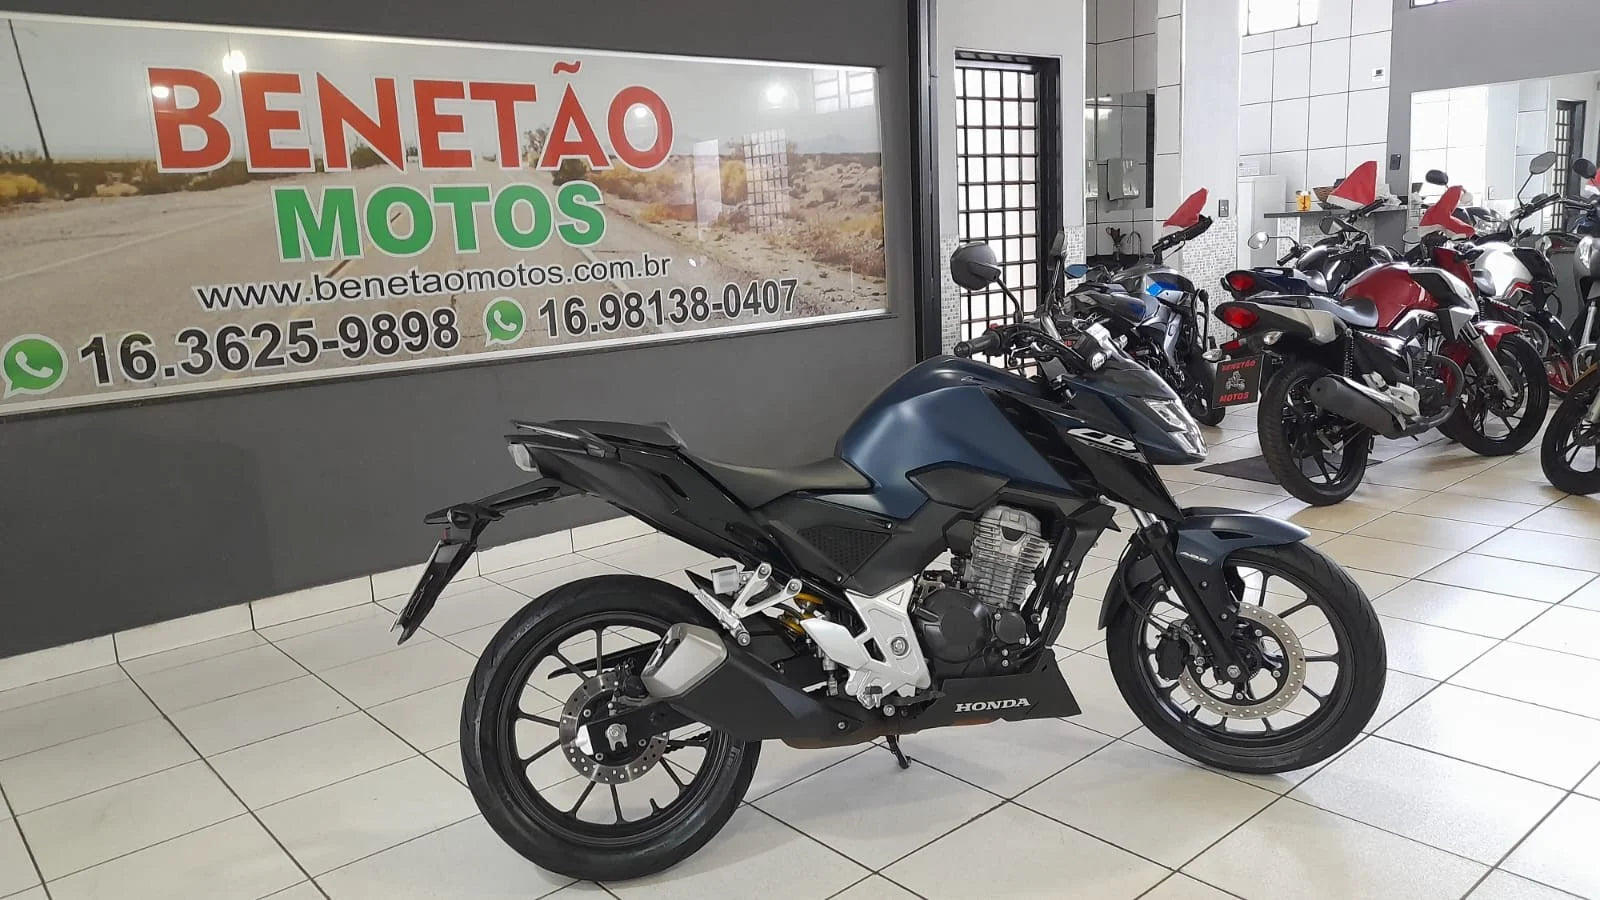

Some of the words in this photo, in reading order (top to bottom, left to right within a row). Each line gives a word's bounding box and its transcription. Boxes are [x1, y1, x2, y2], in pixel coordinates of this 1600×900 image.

[147, 61, 673, 172] BENETÃO
[273, 183, 605, 260] MOTOS
[197, 254, 670, 310] www.benetaomotos.com.br
[539, 279, 798, 337] 16.98138-0407
[80, 307, 459, 384] 16.3625-9898
[1219, 391, 1249, 403] MOTOS
[954, 697, 1031, 713] HONDA
